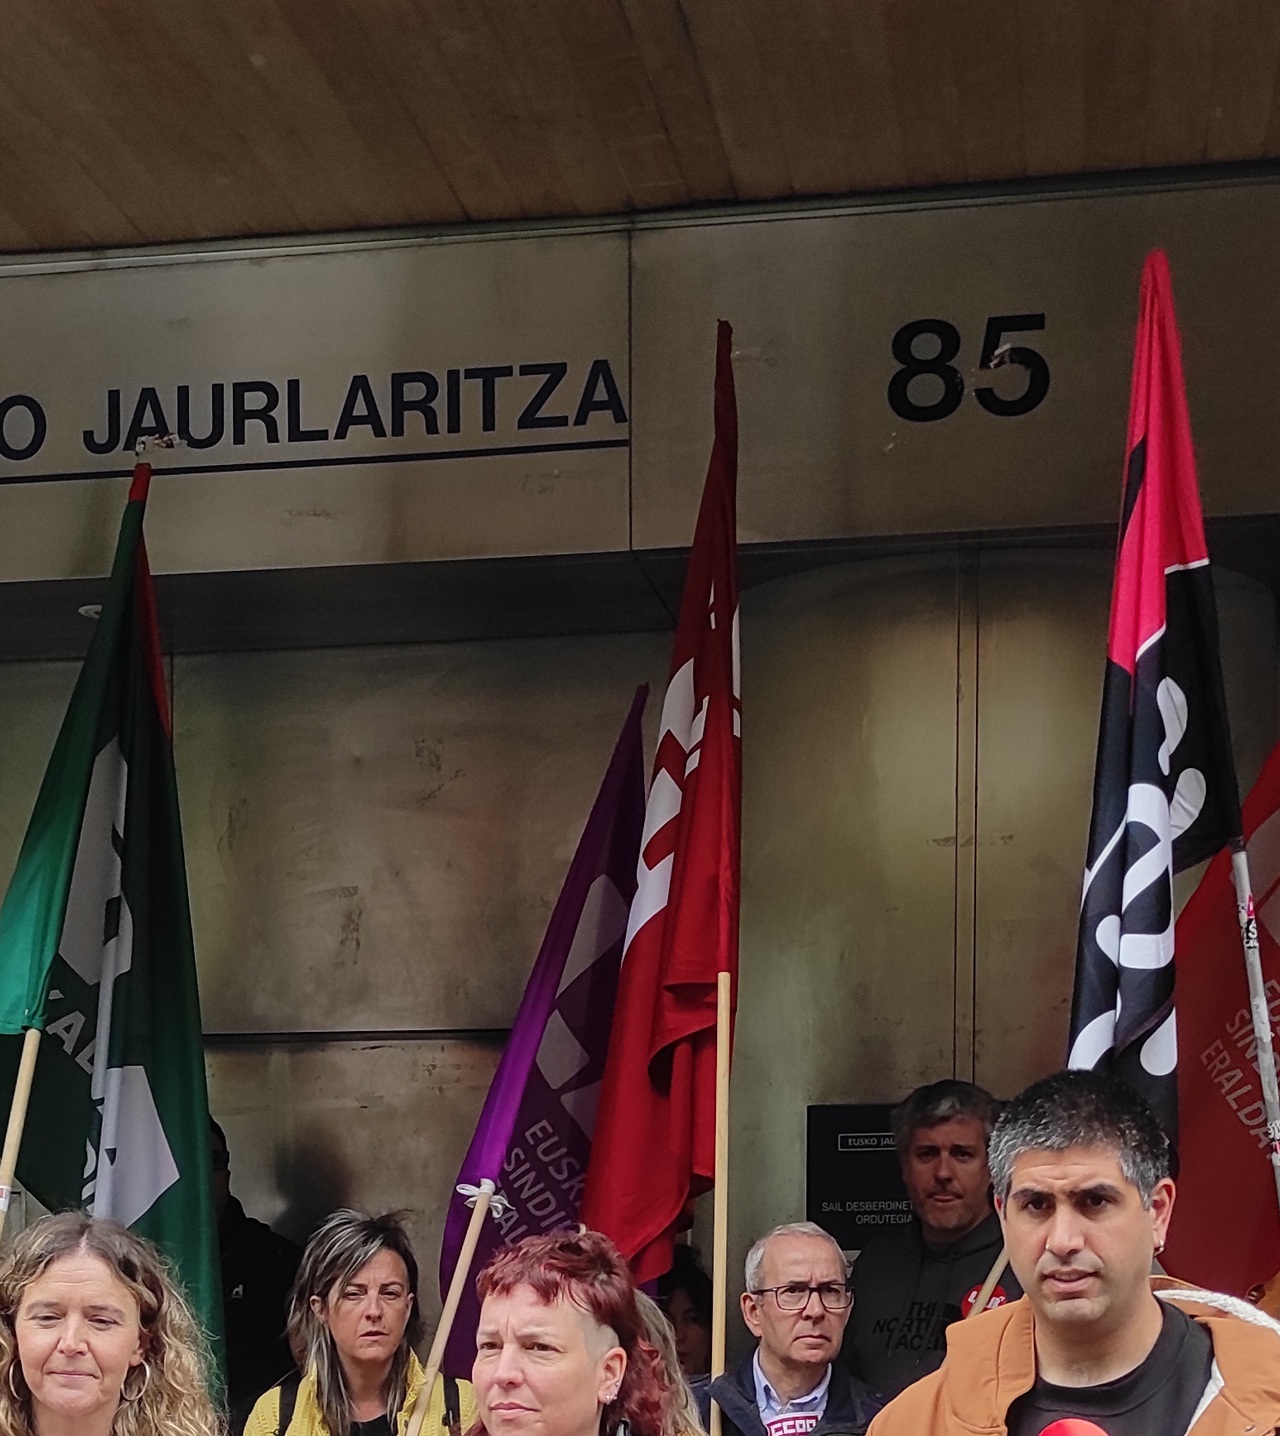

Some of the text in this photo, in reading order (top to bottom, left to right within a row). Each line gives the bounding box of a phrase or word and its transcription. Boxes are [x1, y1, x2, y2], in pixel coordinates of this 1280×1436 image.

[82, 358, 629, 456] JAURLARITZA
[885, 312, 1051, 423] 85
[525, 1119, 586, 1201] EUSK
[822, 1201, 913, 1212] SAIL DESBERDINET
